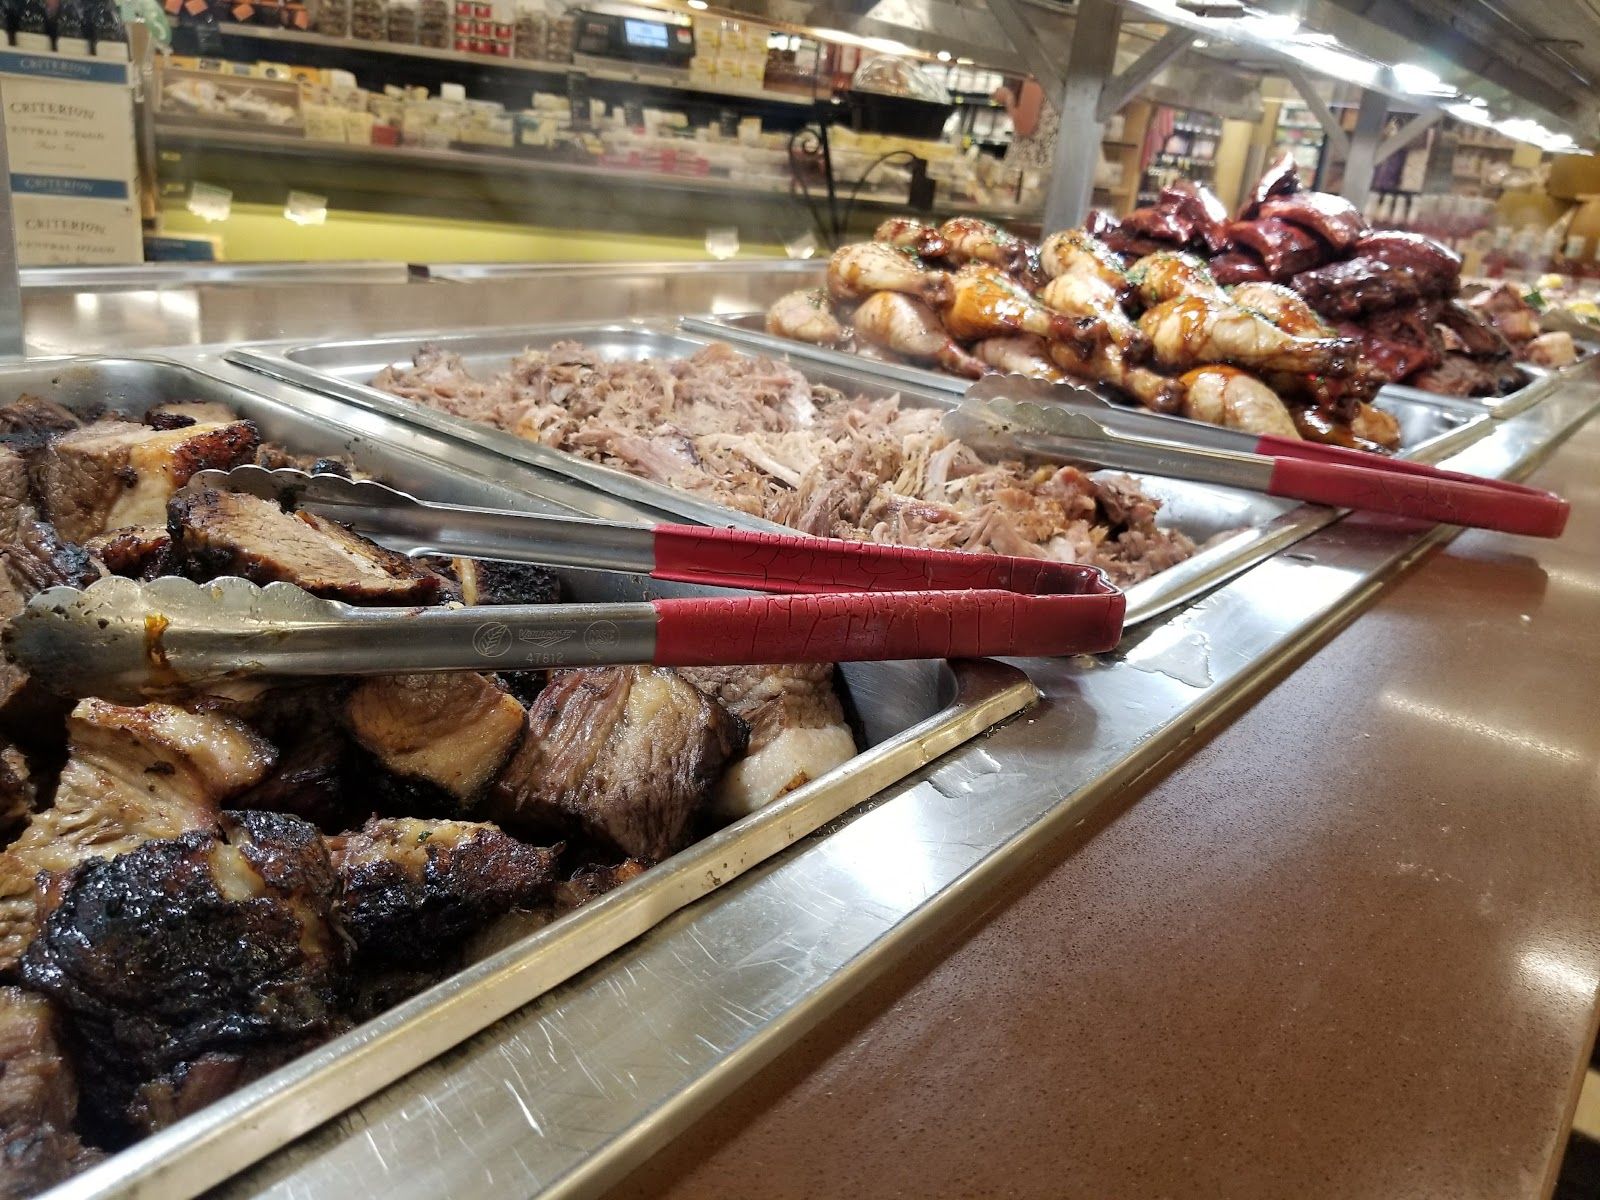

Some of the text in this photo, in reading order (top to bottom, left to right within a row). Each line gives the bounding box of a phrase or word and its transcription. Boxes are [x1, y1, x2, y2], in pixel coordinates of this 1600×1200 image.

[9, 102, 96, 120] CRITERION
[25, 218, 106, 235] CRITERION
[525, 652, 565, 664] 47812
